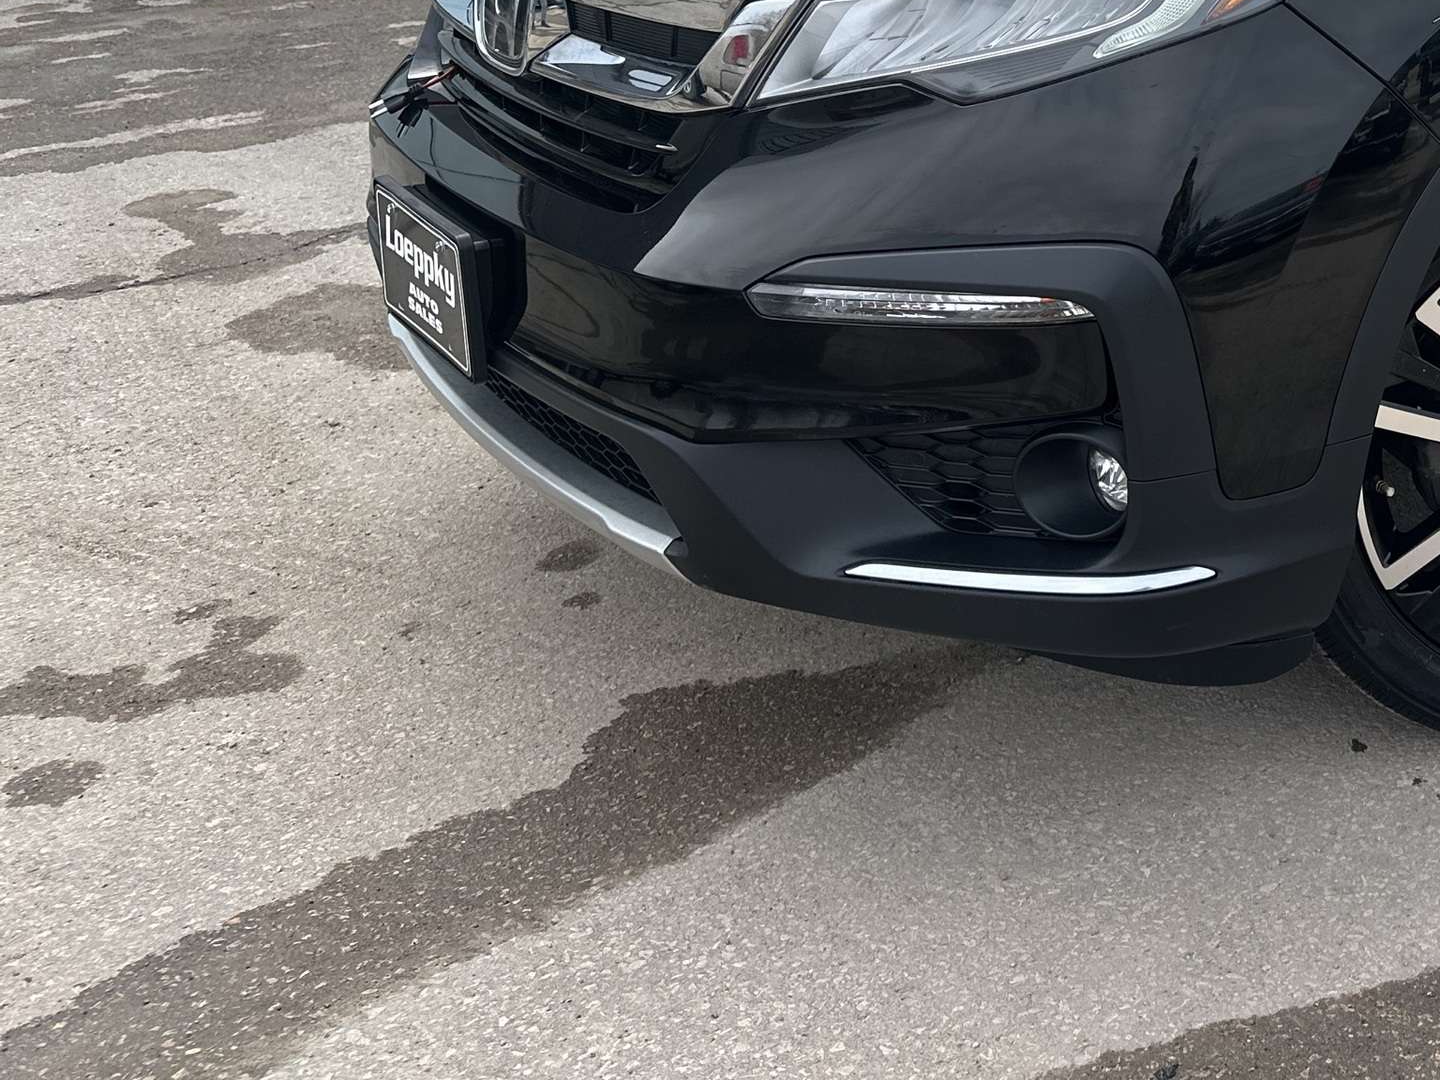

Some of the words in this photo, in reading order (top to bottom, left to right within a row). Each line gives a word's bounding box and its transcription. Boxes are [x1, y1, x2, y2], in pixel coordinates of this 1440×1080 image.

[385, 214, 456, 309] Loeppky
[407, 296, 443, 334] SALES
[409, 281, 440, 315] AUTO
